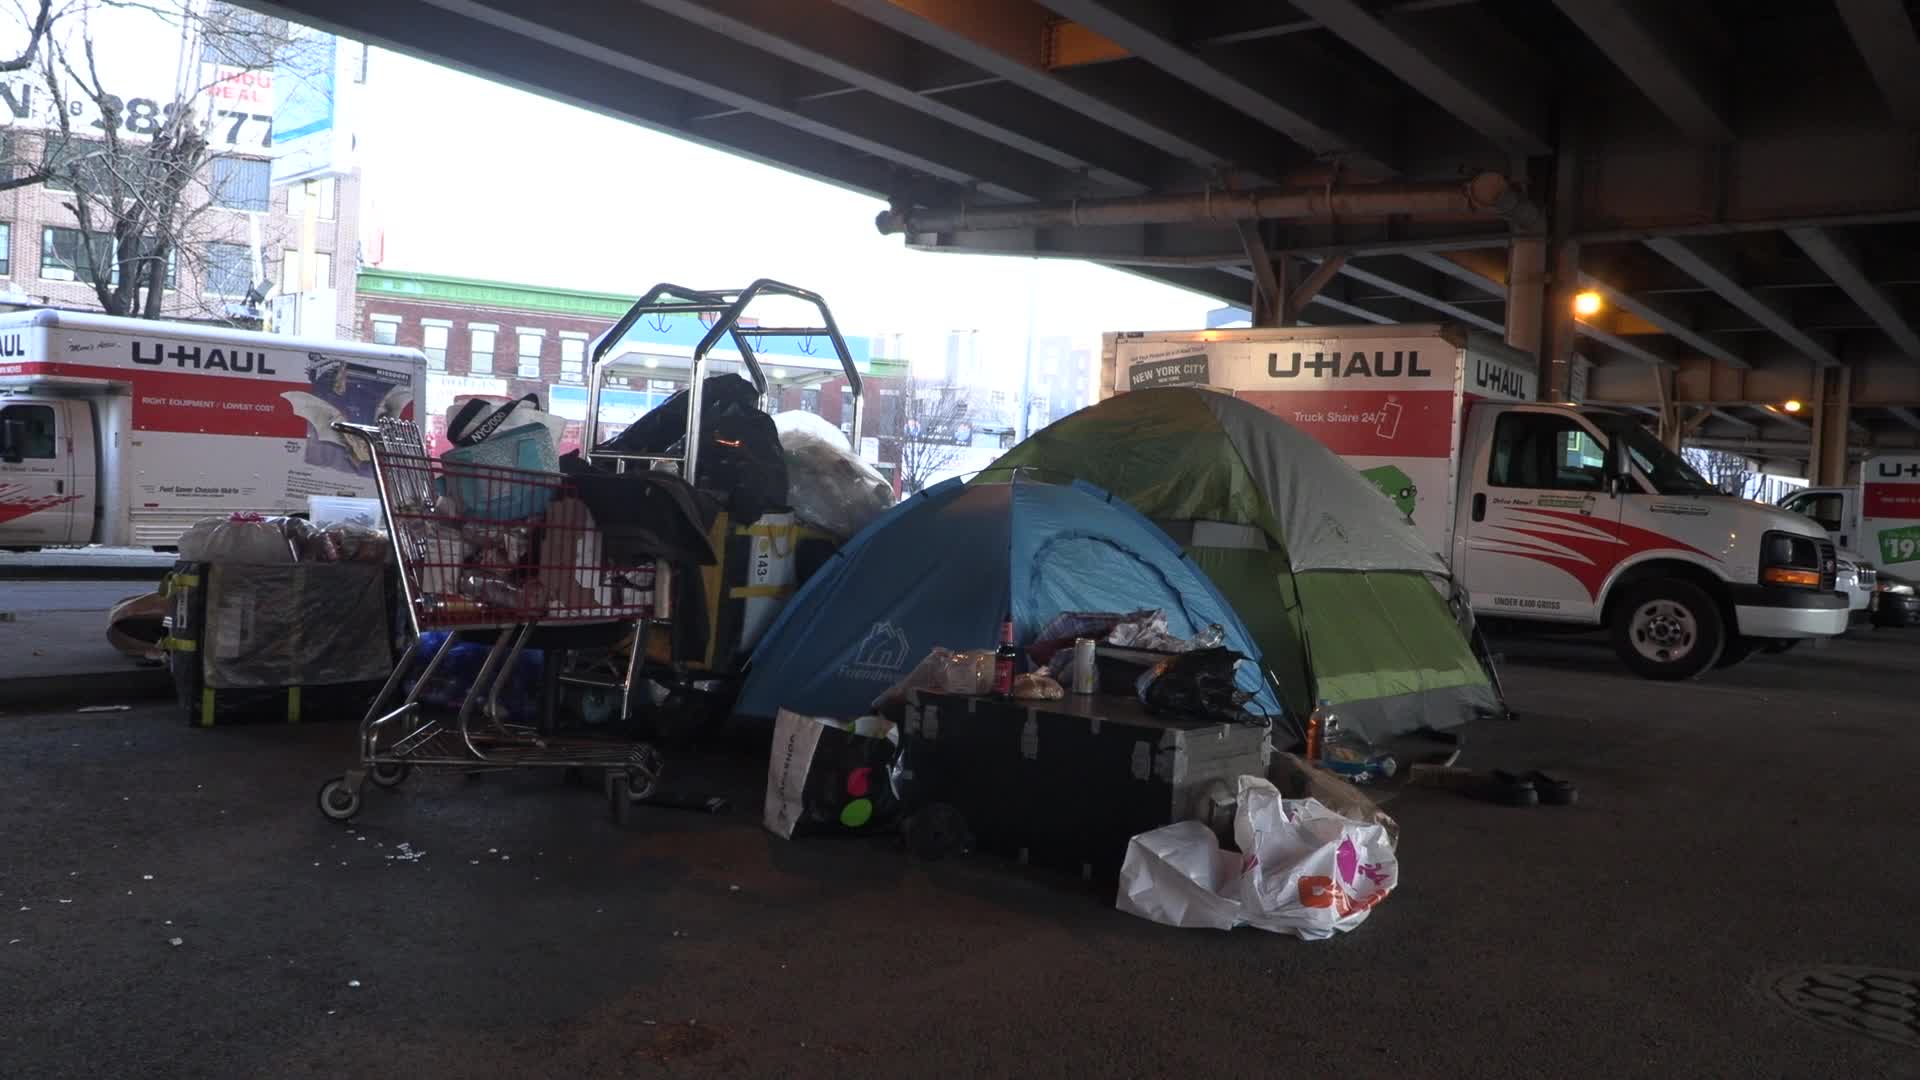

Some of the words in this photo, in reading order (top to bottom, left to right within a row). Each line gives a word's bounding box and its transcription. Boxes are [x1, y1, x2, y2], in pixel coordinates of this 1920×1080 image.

[1132, 370, 1154, 385] NEW
[1156, 364, 1181, 378] YORK
[1183, 363, 1206, 375] CITY
[255, 404, 275, 412] COST
[1294, 411, 1325, 423] Truck
[1327, 411, 1359, 423] Share
[1361, 411, 1388, 425] 24/7
